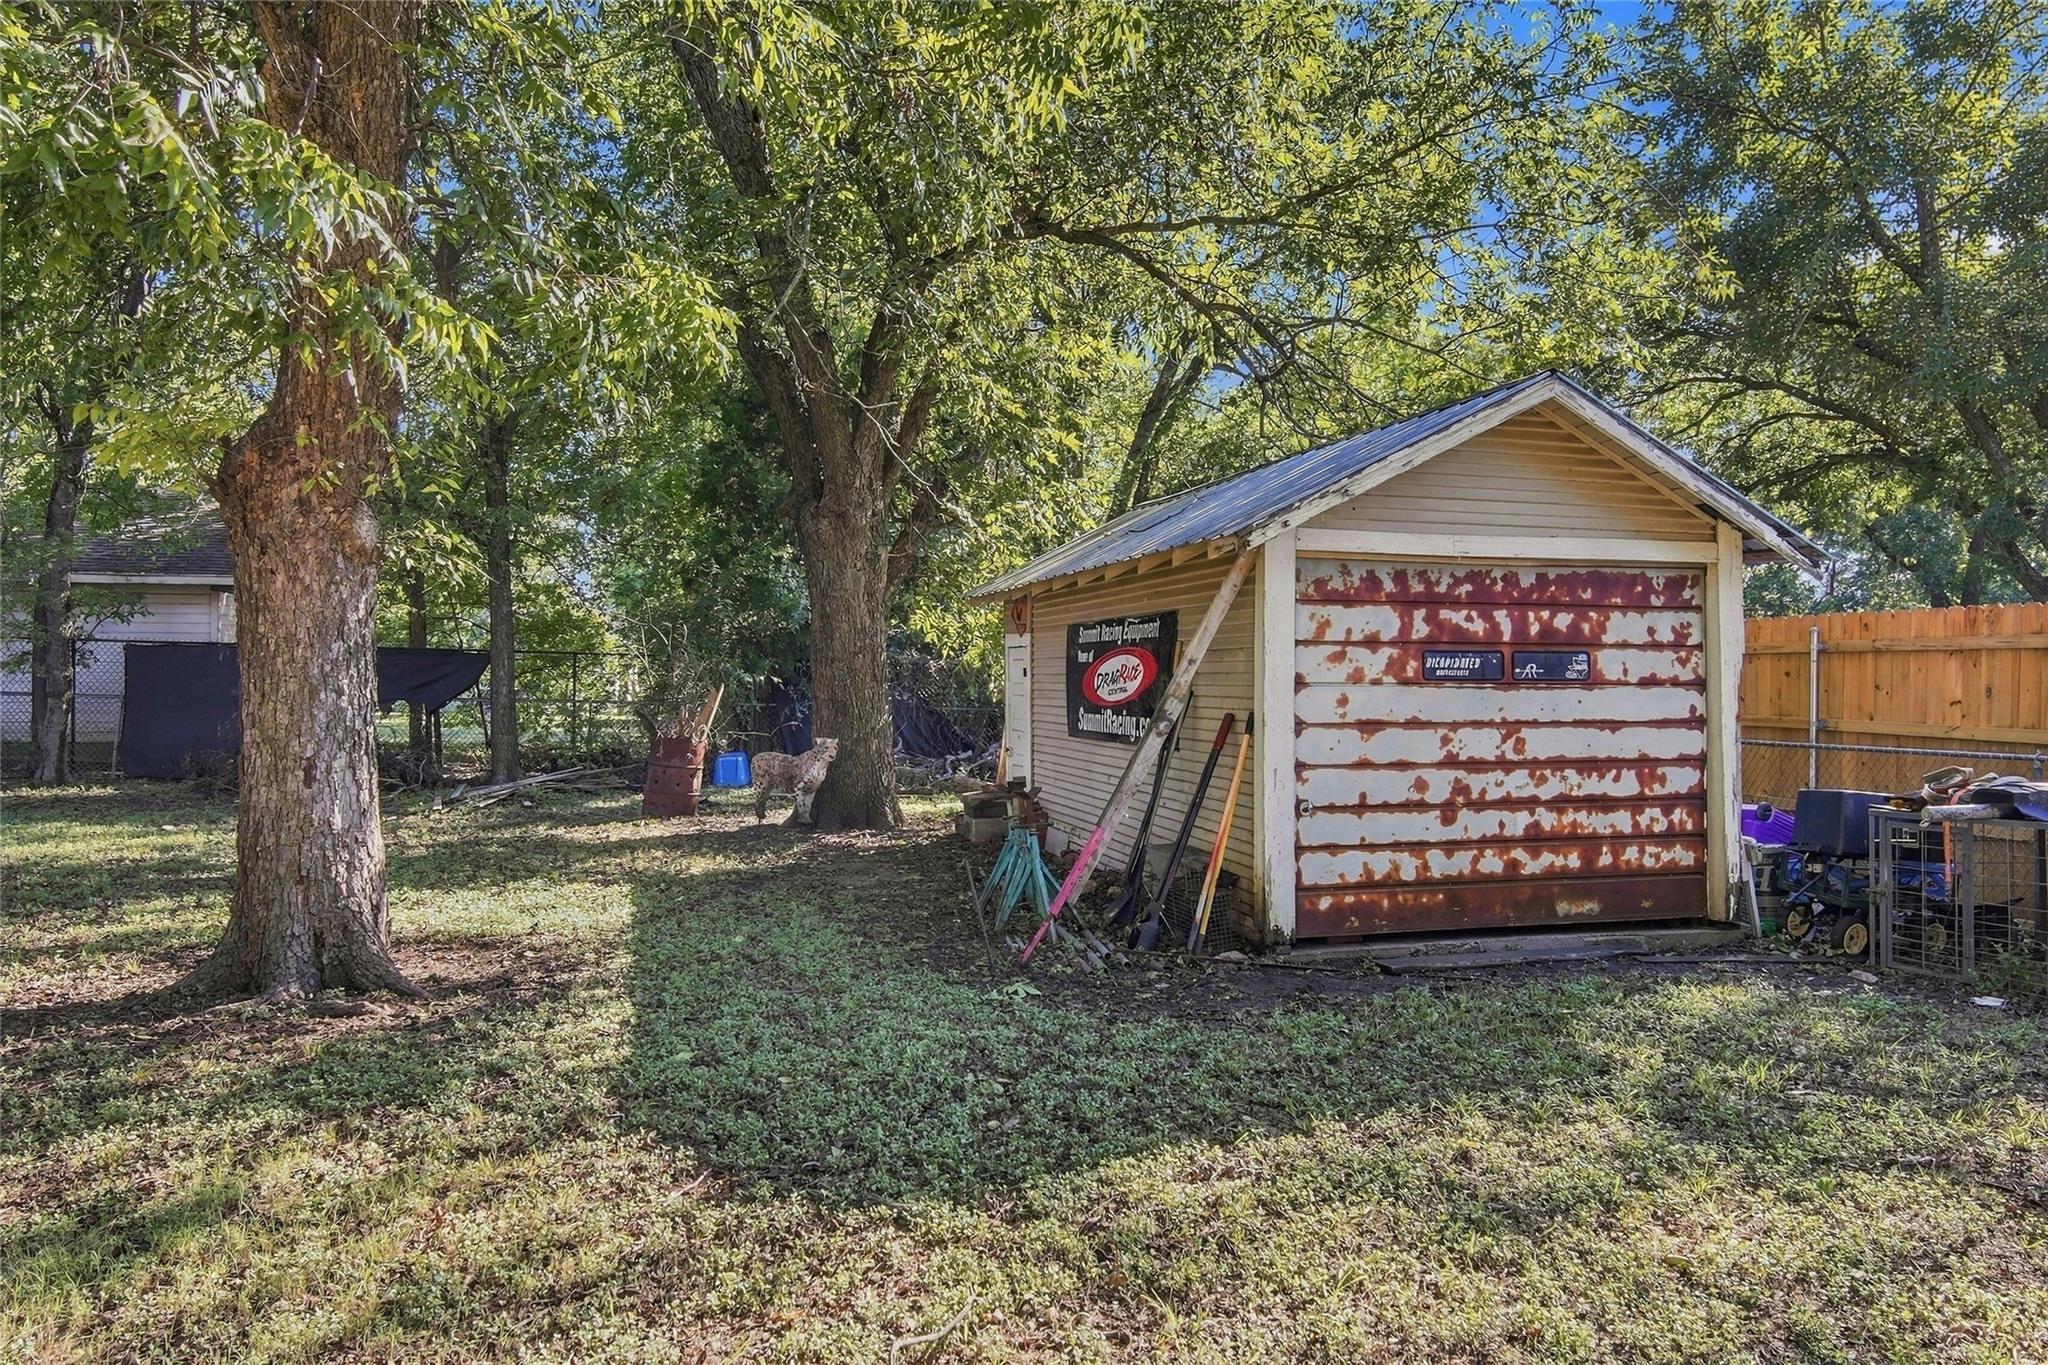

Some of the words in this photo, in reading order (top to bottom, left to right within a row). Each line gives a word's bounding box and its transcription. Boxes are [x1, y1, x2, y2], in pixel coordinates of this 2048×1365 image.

[1078, 625, 1100, 643] Summit
[1101, 623, 1123, 645] Racing
[1123, 618, 1161, 643] Equipment
[1078, 706, 1151, 742] SummitRacing.co
